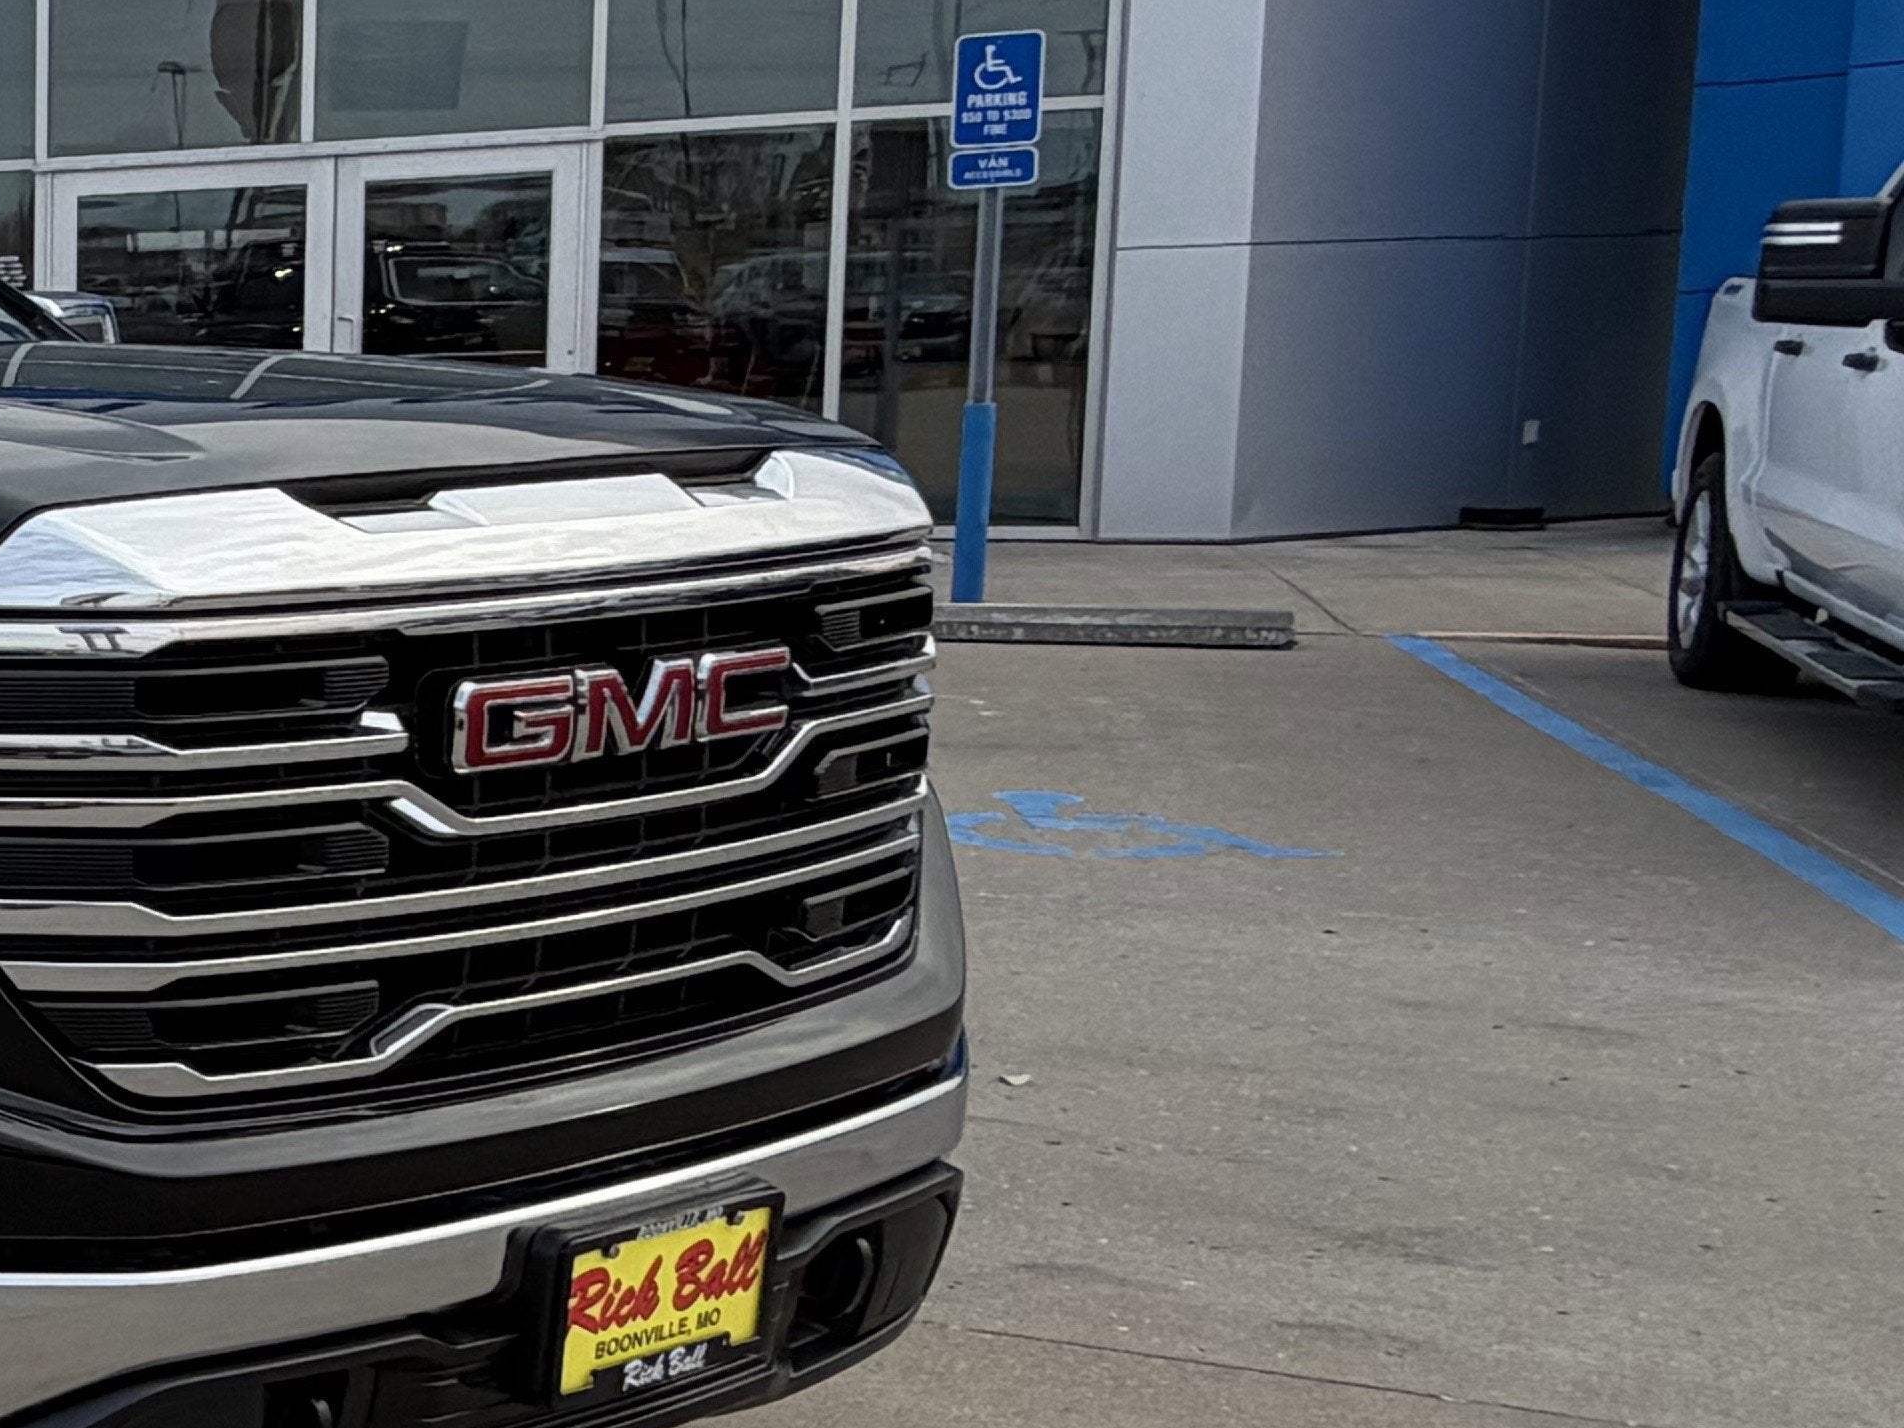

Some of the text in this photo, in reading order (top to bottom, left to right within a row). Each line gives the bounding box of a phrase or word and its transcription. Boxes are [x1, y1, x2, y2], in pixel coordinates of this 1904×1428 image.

[967, 91, 1028, 109] PARKING
[986, 110, 1000, 122] TO
[977, 157, 1009, 169] VAN
[452, 646, 790, 774] GMC
[568, 1229, 768, 1334] Rick Ball
[594, 1307, 721, 1359] BOONVILLE, MO
[622, 1342, 708, 1392] Rick Ball
